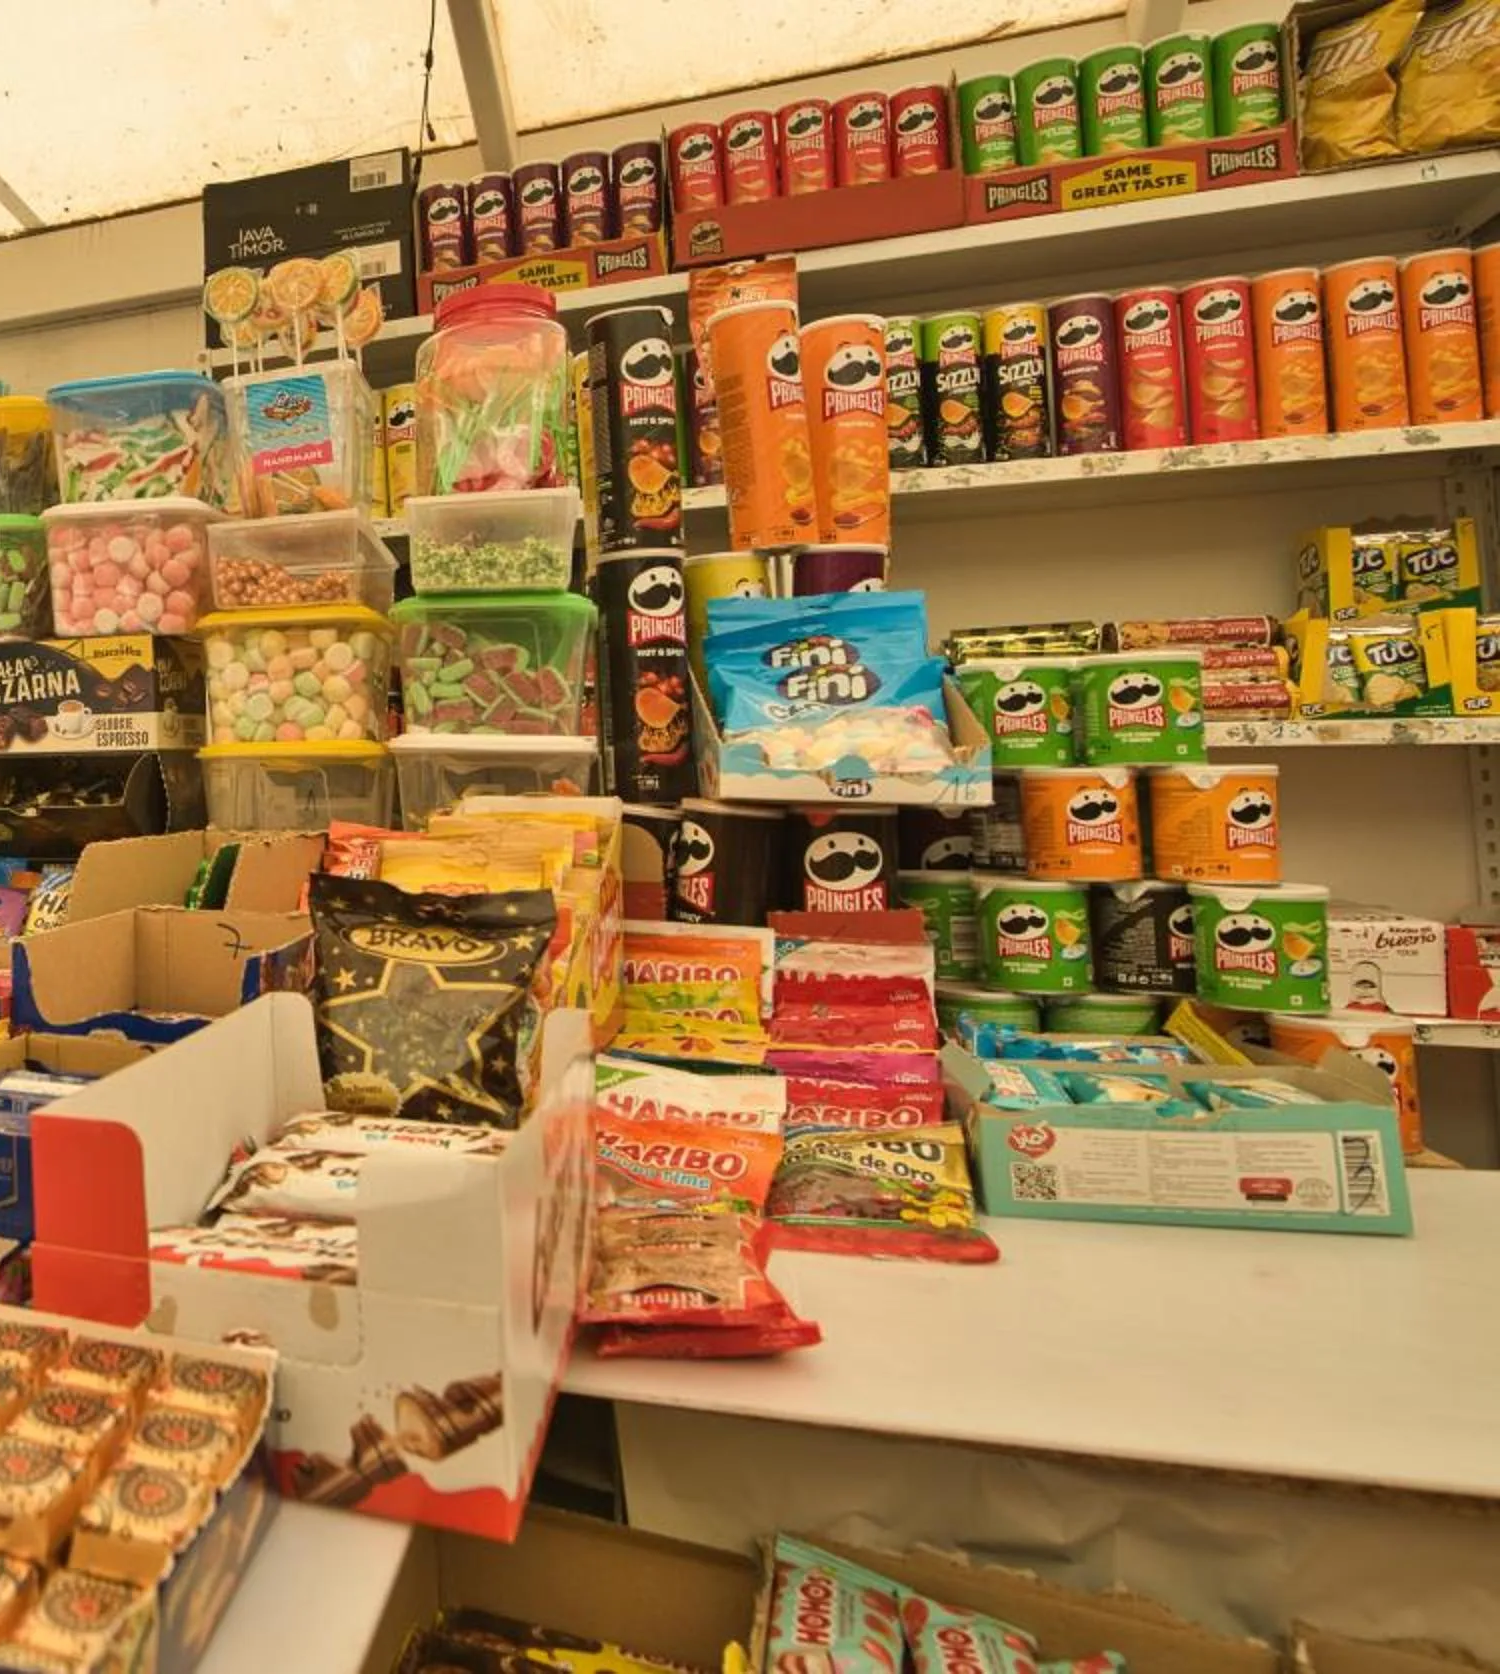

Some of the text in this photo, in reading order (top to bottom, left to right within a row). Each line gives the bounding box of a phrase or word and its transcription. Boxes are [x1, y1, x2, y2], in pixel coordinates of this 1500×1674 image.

[1157, 81, 1205, 107] PRINGLES
[1211, 144, 1277, 176] PRINGLES
[1102, 164, 1153, 182] SAME
[988, 179, 1049, 209] PRINGLES
[1071, 174, 1189, 201] GREAT TASTE
[228, 239, 287, 260] TIMOR
[597, 247, 649, 276] PRINGLES
[517, 264, 557, 279] SAME
[540, 272, 582, 287] TASTE
[1348, 312, 1399, 337] PRINGLES
[1422, 306, 1473, 330] PRINGLES
[1124, 330, 1173, 353] PRINGLES
[1196, 319, 1244, 343] PRINGLES
[1057, 343, 1104, 370] PRINGLES
[825, 389, 885, 419] PRINGLES
[1352, 549, 1384, 572] UC
[1407, 546, 1457, 574] TUC
[771, 639, 847, 669] Fini
[1367, 640, 1415, 665] TUC
[787, 666, 867, 701] Fini
[996, 714, 1048, 736] PRINGLES
[1109, 706, 1165, 729] PRINGLES
[97, 730, 149, 747] ESPRESSO
[1068, 823, 1122, 846] PRINGLES
[1229, 824, 1275, 849] PRINGLES
[806, 886, 884, 912] PRINGLES
[366, 926, 477, 955] BRAVO
[998, 936, 1051, 960] PRINGLES
[1375, 932, 1437, 951] bueno
[1216, 948, 1278, 976] PRINGLES
[785, 1106, 923, 1128] ARIBO
[596, 1130, 748, 1180] HARIBO
[860, 1150, 888, 1170] de
[892, 1160, 935, 1184] Oro
